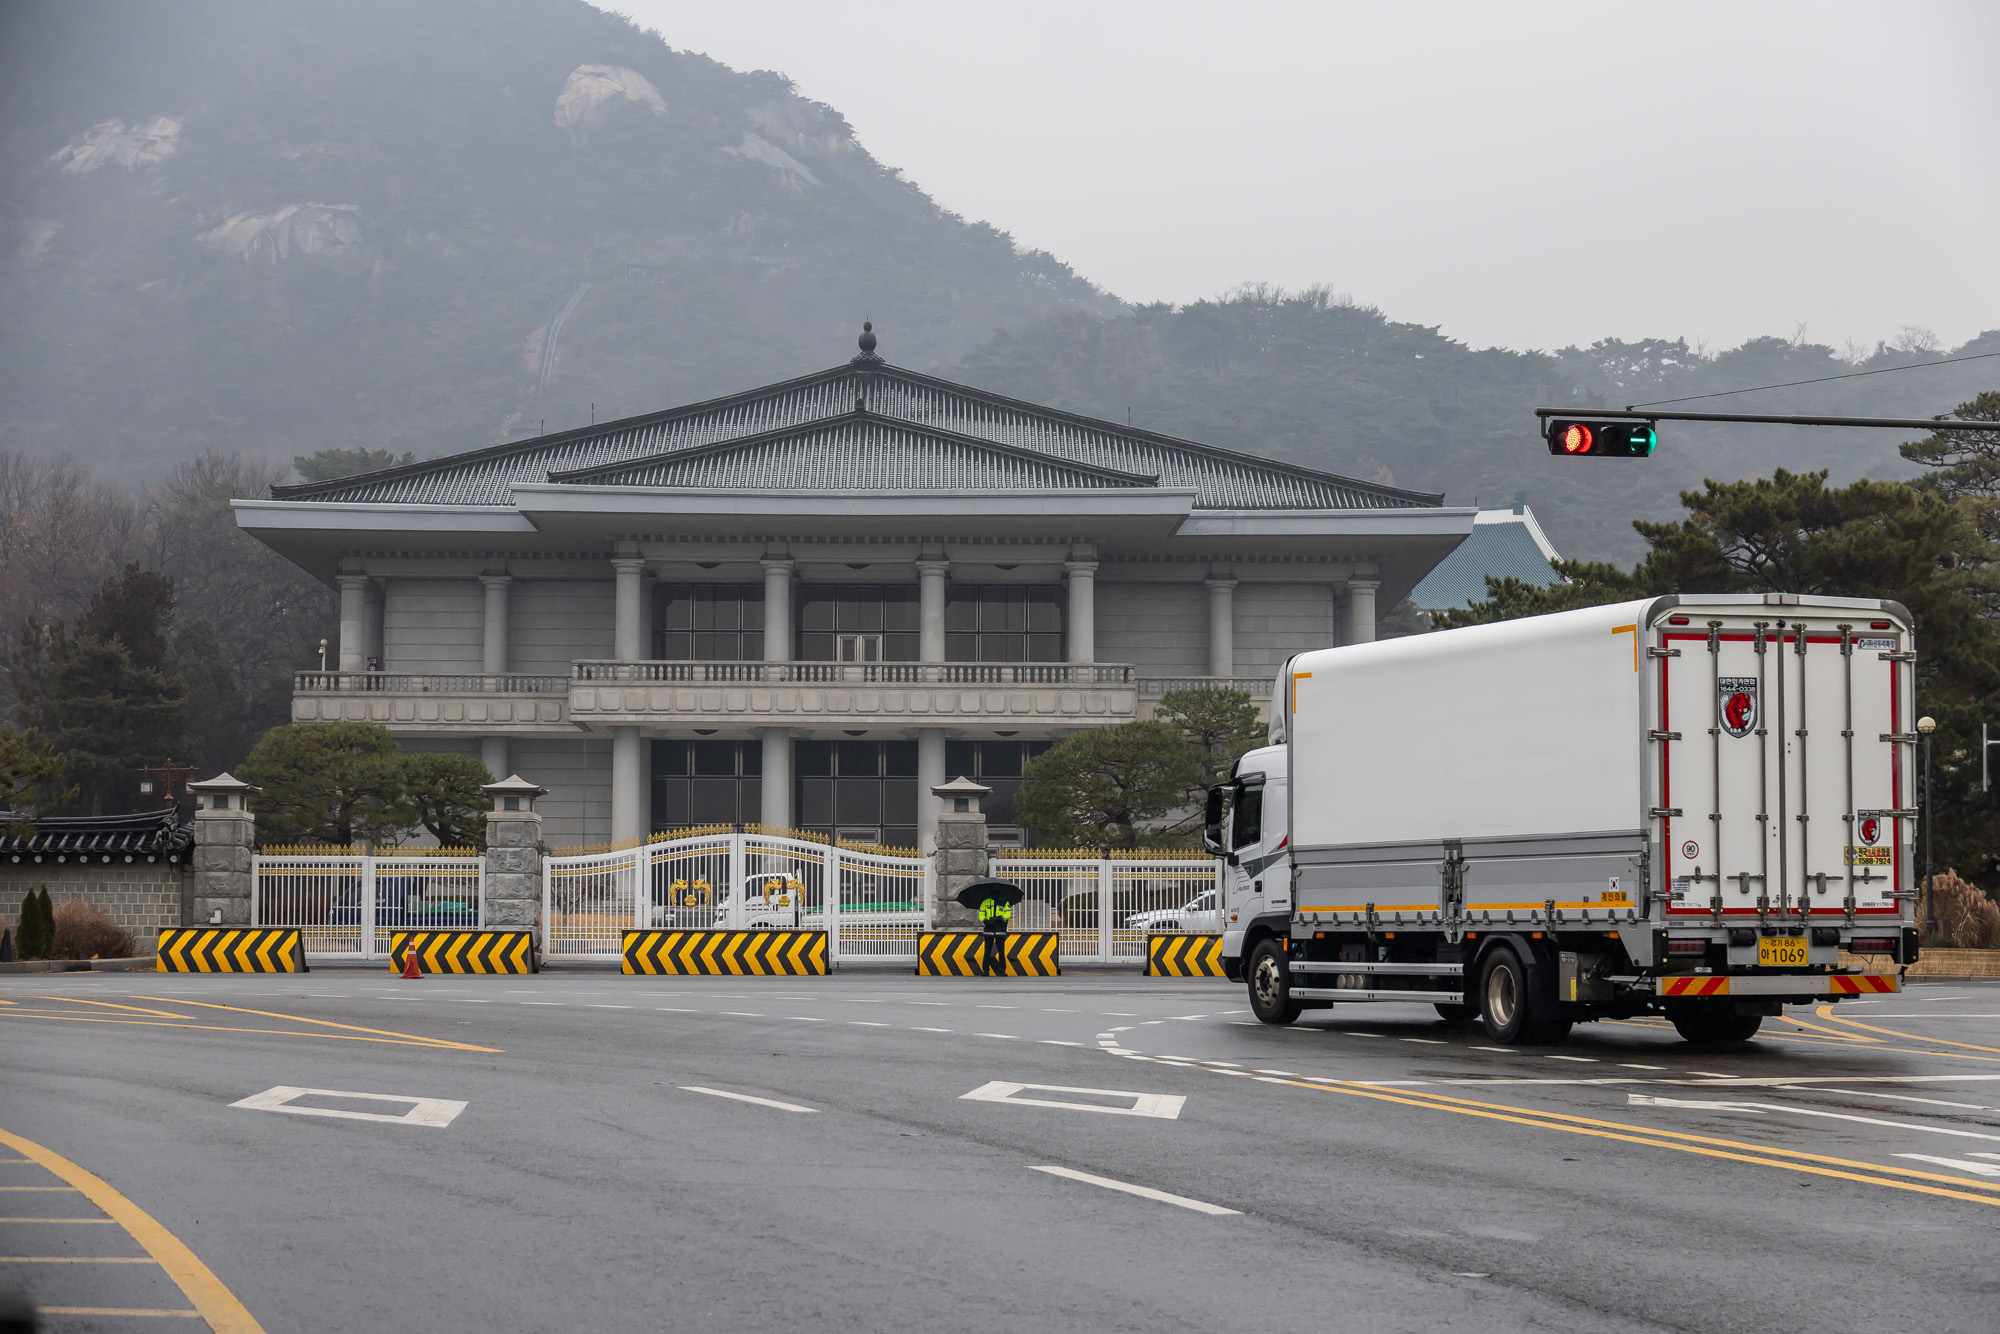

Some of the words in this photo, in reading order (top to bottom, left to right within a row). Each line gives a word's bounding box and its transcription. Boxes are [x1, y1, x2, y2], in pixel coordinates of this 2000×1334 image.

[1858, 857, 1891, 865] 1588-7924
[1770, 939, 1783, 947] 경기
[1784, 939, 1796, 947] 86
